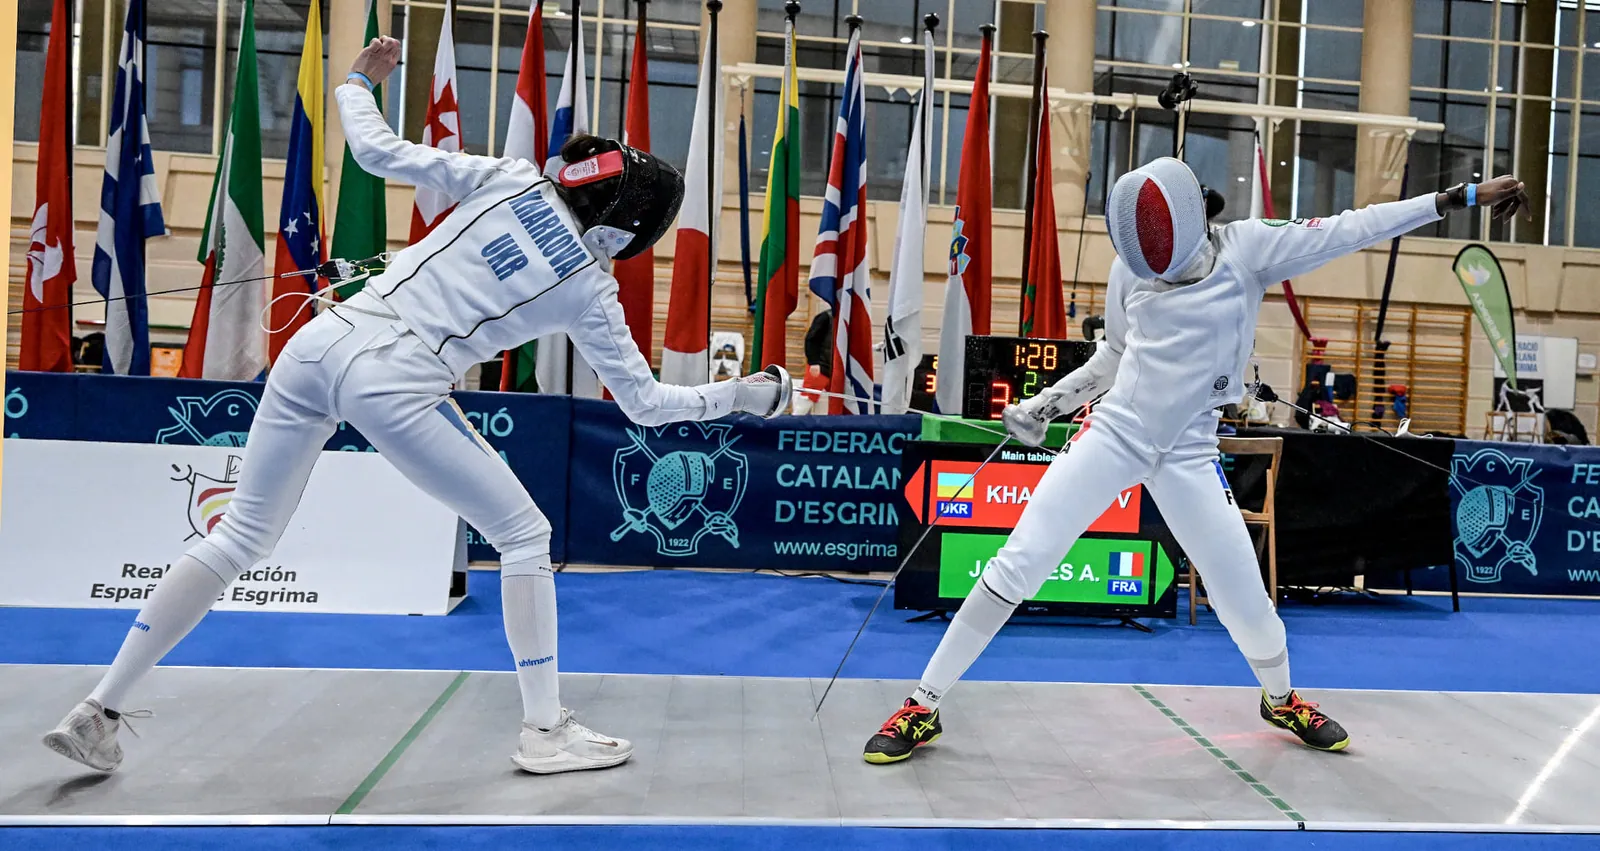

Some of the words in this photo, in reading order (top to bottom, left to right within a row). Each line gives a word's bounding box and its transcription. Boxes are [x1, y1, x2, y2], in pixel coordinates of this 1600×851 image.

[508, 190, 588, 279] KHARKOVA
[481, 233, 529, 282] UKR
[1014, 344, 1058, 370] 1:28
[1023, 371, 1037, 396] 2
[991, 383, 1010, 418] 3
[227, 403, 240, 416] C
[678, 426, 689, 437] C
[778, 430, 922, 455] FEDERAC
[1001, 450, 1025, 461] Main
[1027, 452, 1056, 462] tablea
[1486, 461, 1496, 472] C
[631, 474, 640, 485] F
[723, 478, 733, 490] E
[940, 502, 968, 514] UKR
[1521, 508, 1531, 521] E
[668, 538, 689, 547] 1922
[773, 540, 898, 561] www.esgrima
[239, 565, 297, 582] ación
[1078, 564, 1100, 582] A.
[1475, 566, 1494, 574] 1922
[1112, 581, 1137, 593] FRA
[231, 587, 318, 605] Esgrima
[518, 655, 554, 668] uhlmann
